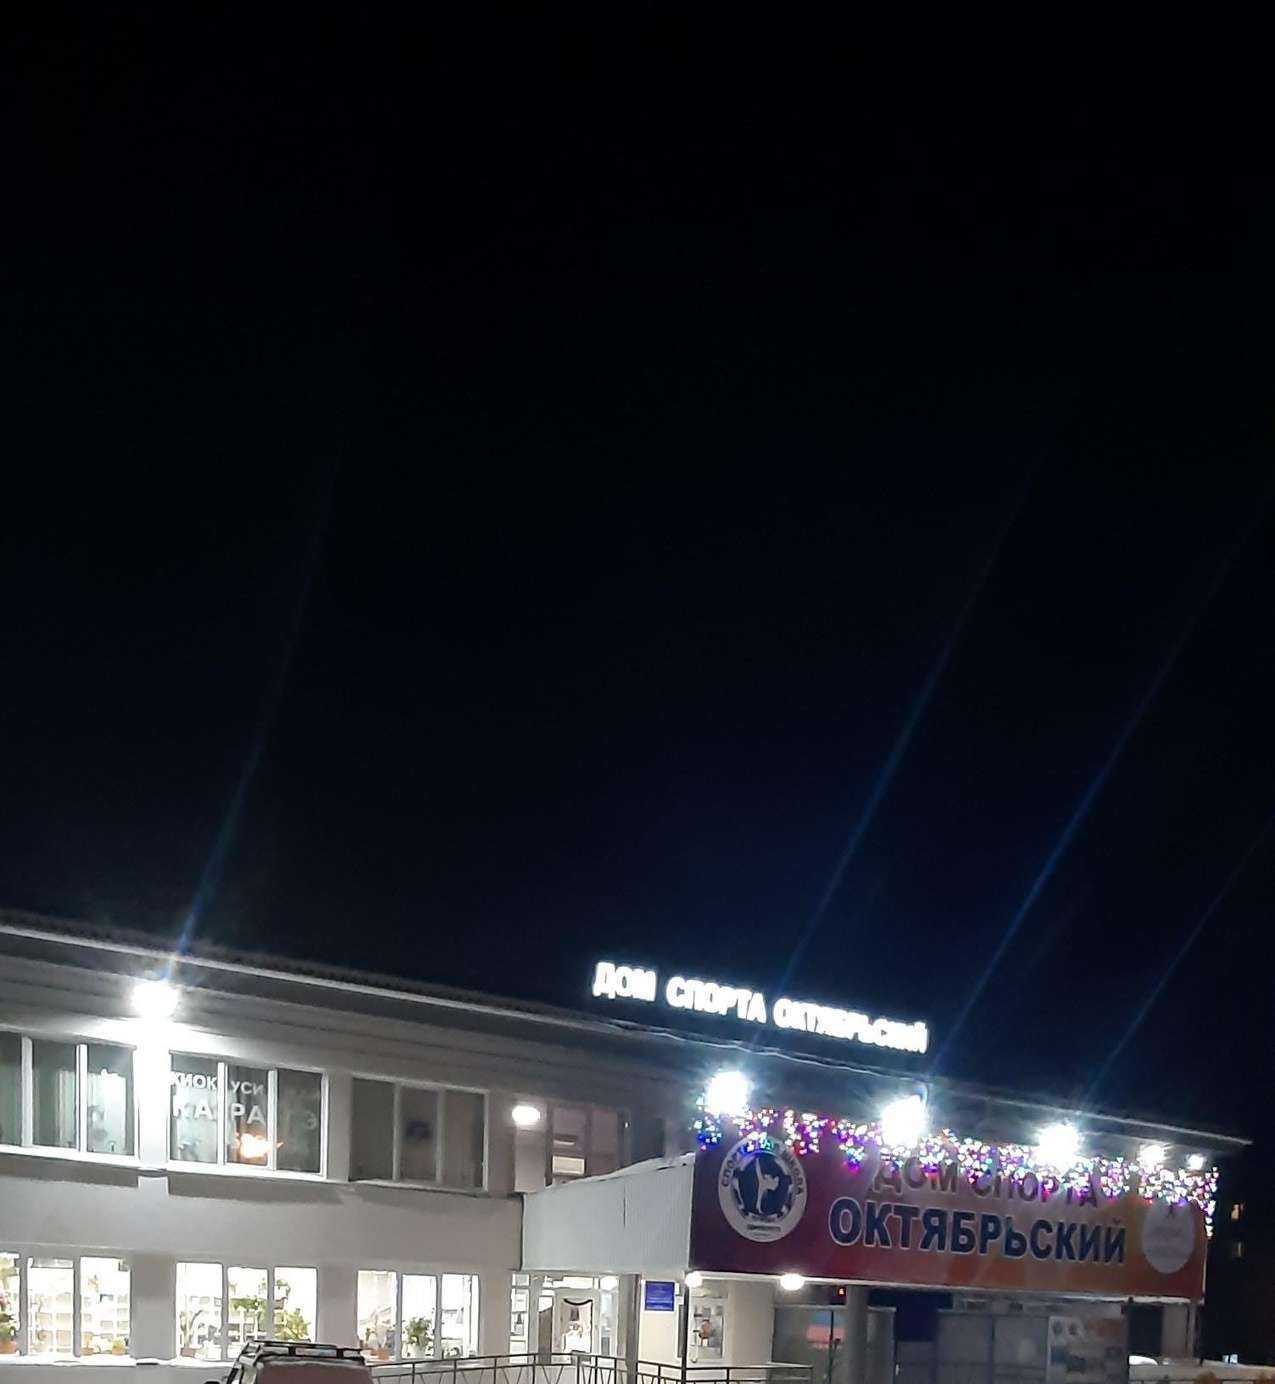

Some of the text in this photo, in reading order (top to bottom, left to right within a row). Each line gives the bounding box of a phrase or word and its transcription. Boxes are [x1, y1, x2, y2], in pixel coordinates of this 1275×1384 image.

[593, 961, 656, 1001] ДОМ
[666, 976, 767, 1024] СПОРТА
[872, 1152, 959, 1196] ДОМ
[829, 1197, 1127, 1264] ОКТЯБРЬСКИЙ
